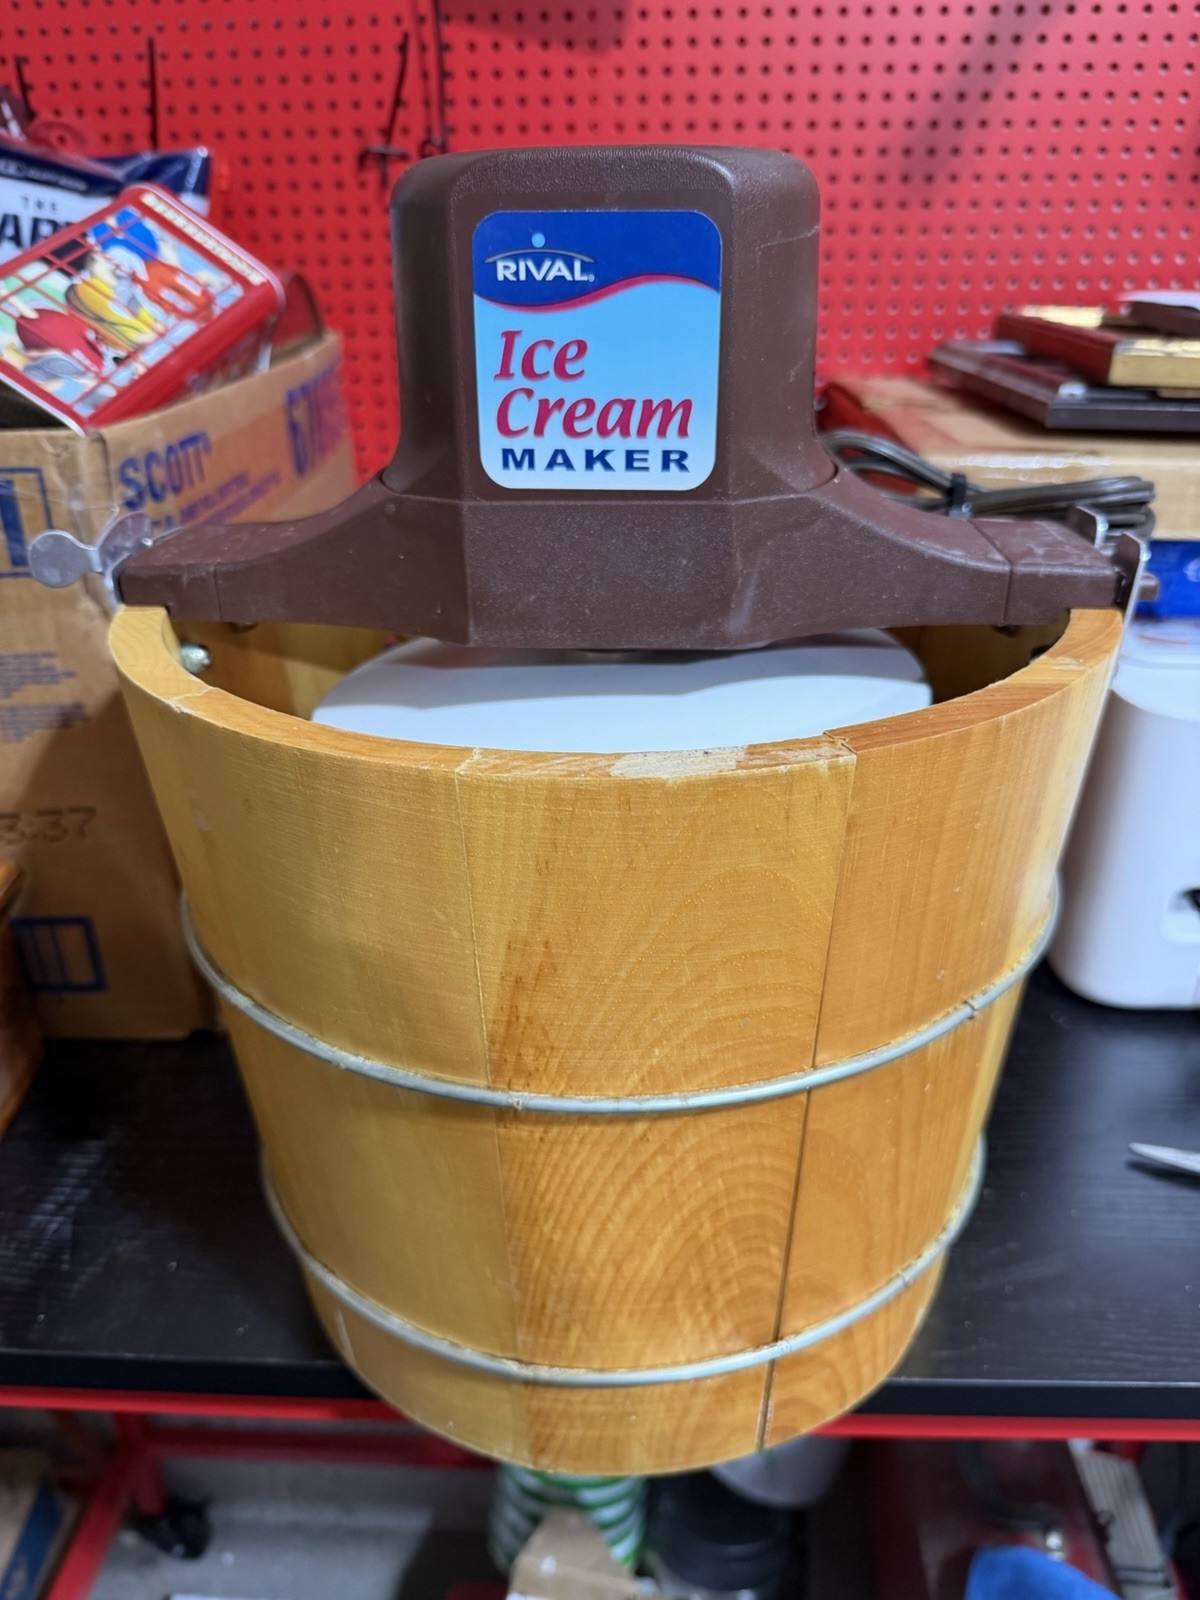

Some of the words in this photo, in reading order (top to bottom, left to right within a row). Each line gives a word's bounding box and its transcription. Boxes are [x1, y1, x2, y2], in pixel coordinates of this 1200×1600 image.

[494, 329, 588, 381] Ice
[496, 387, 693, 439] Cream
[118, 431, 211, 510] SCOTT
[501, 448, 691, 473] MAKER
